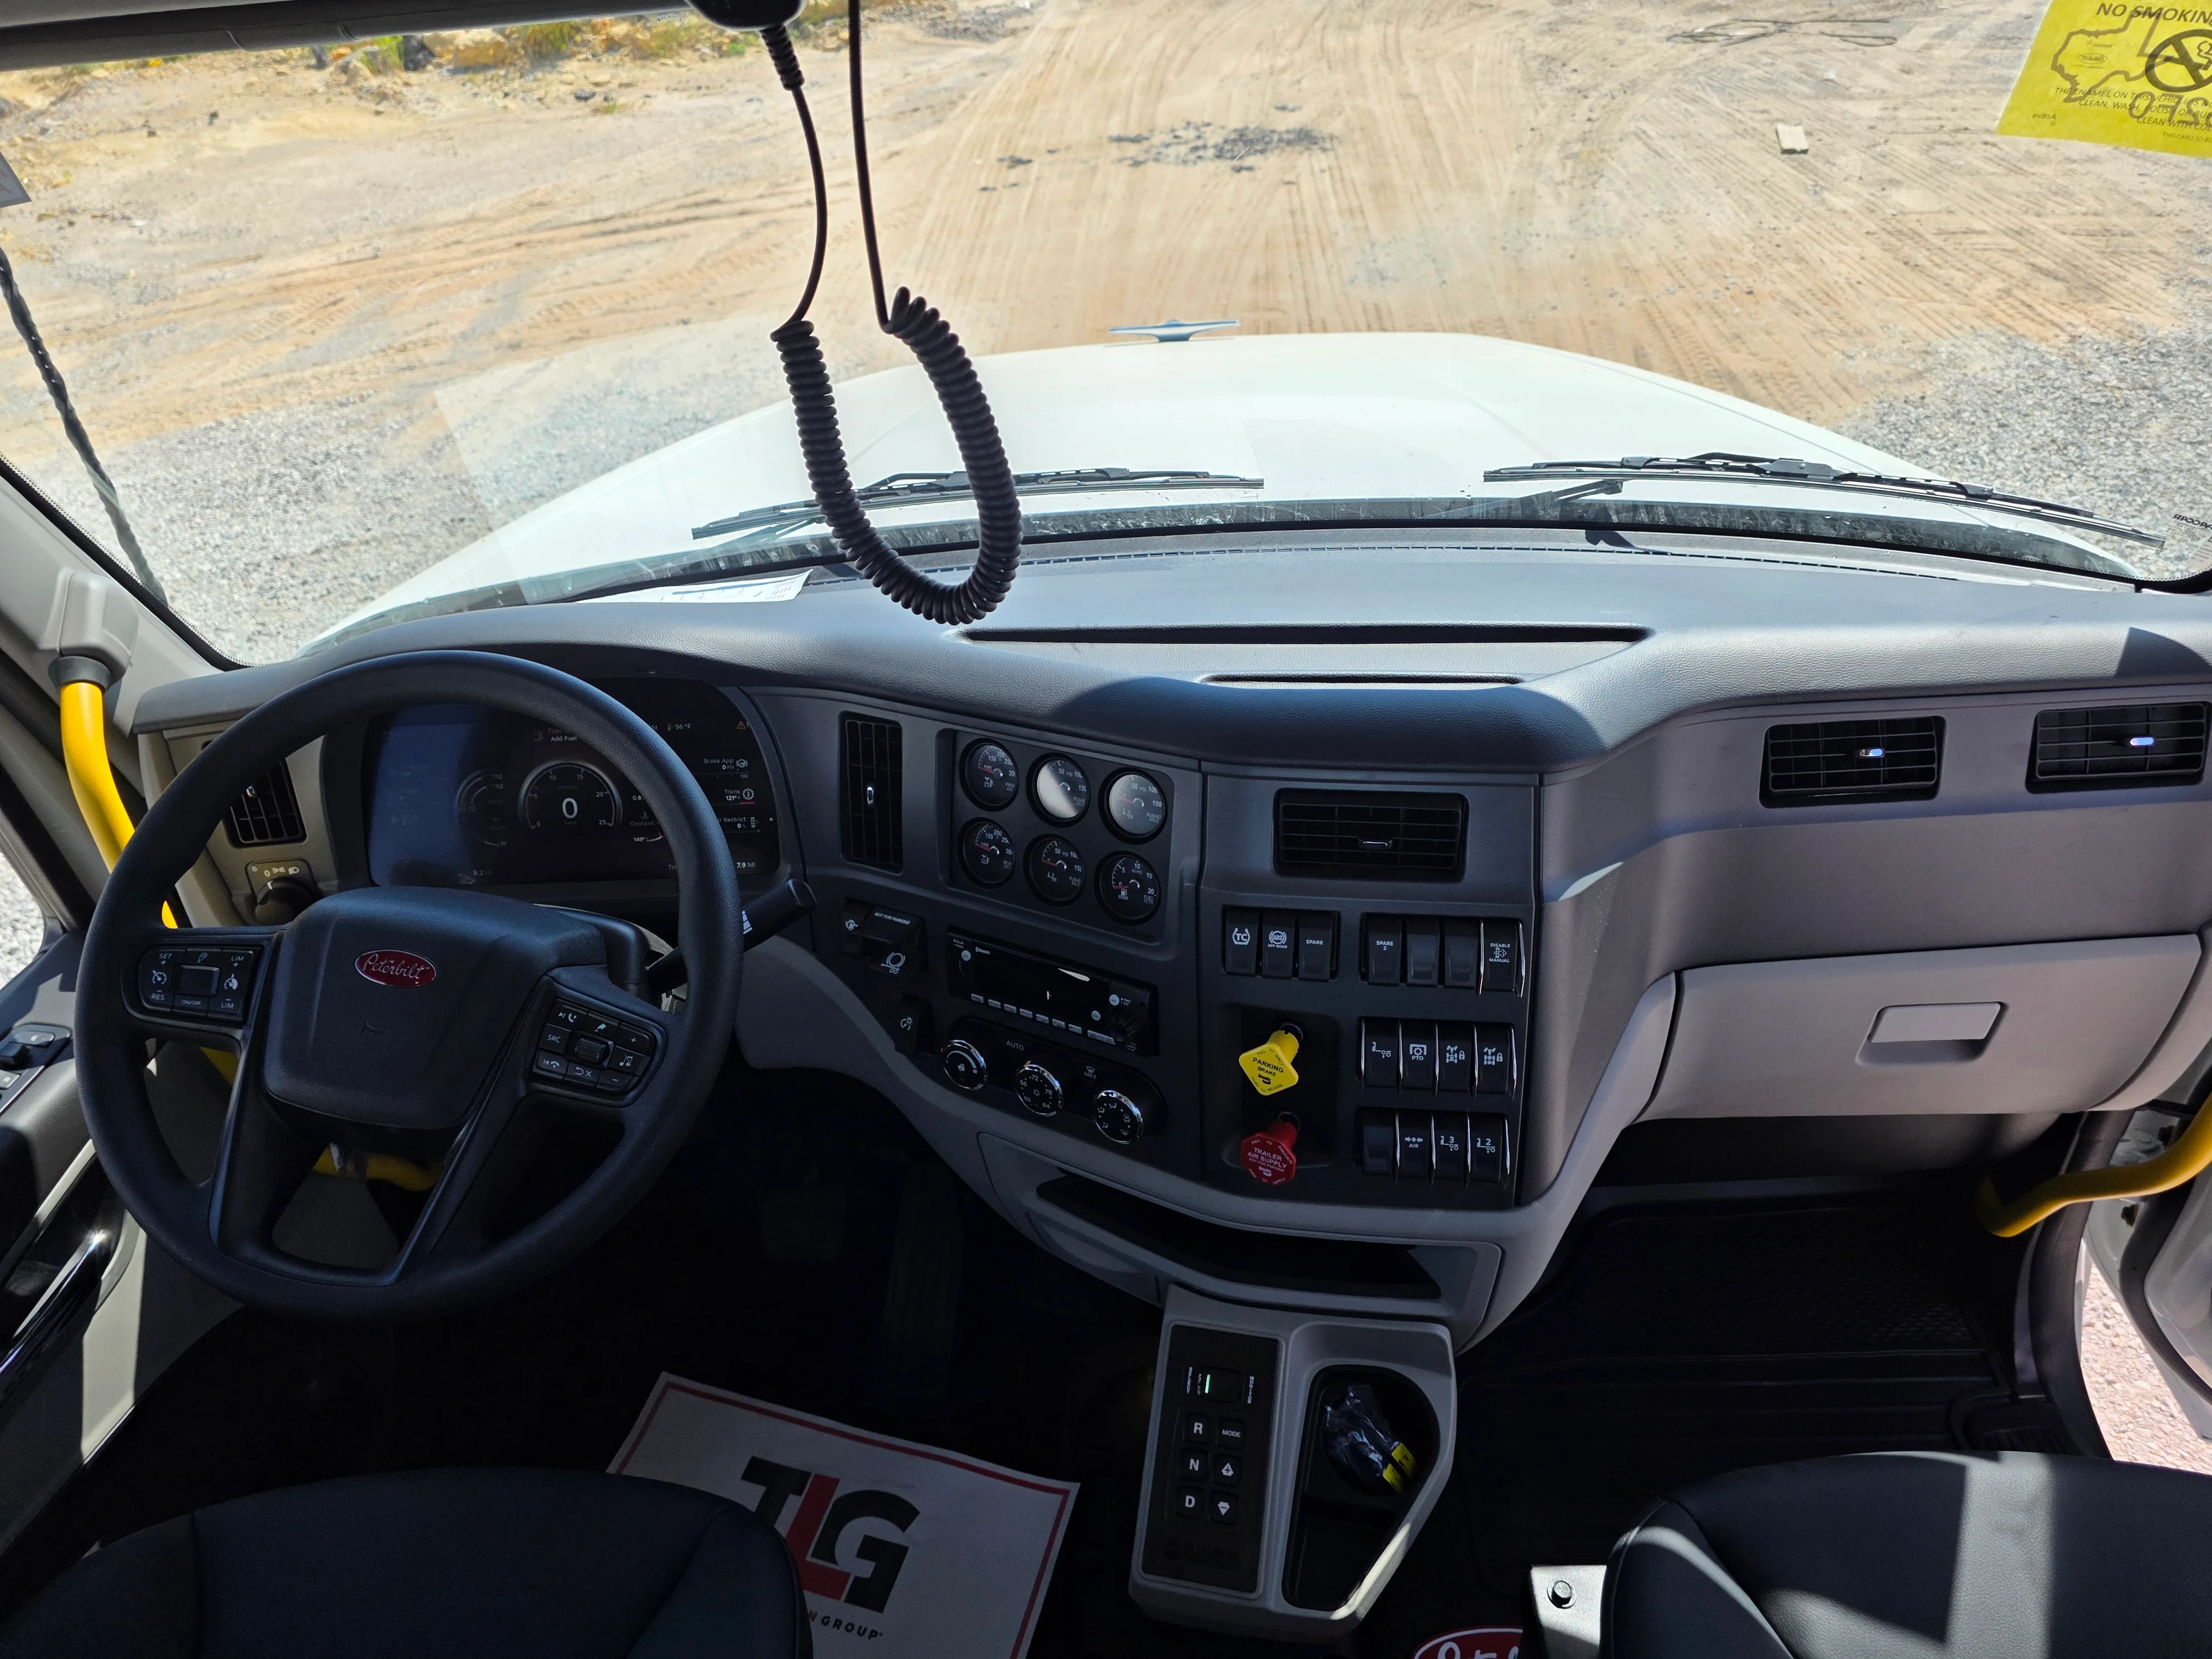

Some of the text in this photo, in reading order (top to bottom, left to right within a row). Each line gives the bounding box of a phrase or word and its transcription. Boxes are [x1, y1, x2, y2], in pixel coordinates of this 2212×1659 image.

[2096, 3, 2127, 17] NO
[2073, 88, 2111, 98] ENAMEL
[2130, 92, 2150, 101] THIS
[2079, 99, 2109, 109] CLEAN,
[2112, 102, 2141, 113] WASH,
[2148, 105, 2175, 114] POLISH
[2137, 116, 2212, 132] CLEAN WITH COL
[562, 797, 578, 819] 0
[892, 917, 911, 925] PARKING
[363, 953, 430, 979] Peterbilt
[547, 1034, 561, 1043] SRC
[1006, 1040, 1024, 1051] AUTO
[1253, 1057, 1284, 1073] PARKING
[1275, 1054, 1284, 1066] APPLY
[1084, 1071, 1097, 1079] MAX
[1258, 1066, 1276, 1077] BRAKE
[1267, 1083, 1283, 1092] RELEASE
[1247, 1151, 1287, 1168] AIR SUPPLY
[1254, 1147, 1282, 1161] TRAILER
[1277, 1145, 1293, 1165] EVACUATE
[1266, 1163, 1285, 1172] PARKING
[1193, 1422, 1203, 1434] R
[1222, 1429, 1241, 1438] MODE
[1189, 1458, 1199, 1471] N
[1185, 1495, 1196, 1508] D
[740, 1455, 920, 1613] TLG
[821, 1615, 879, 1640] GROUP
